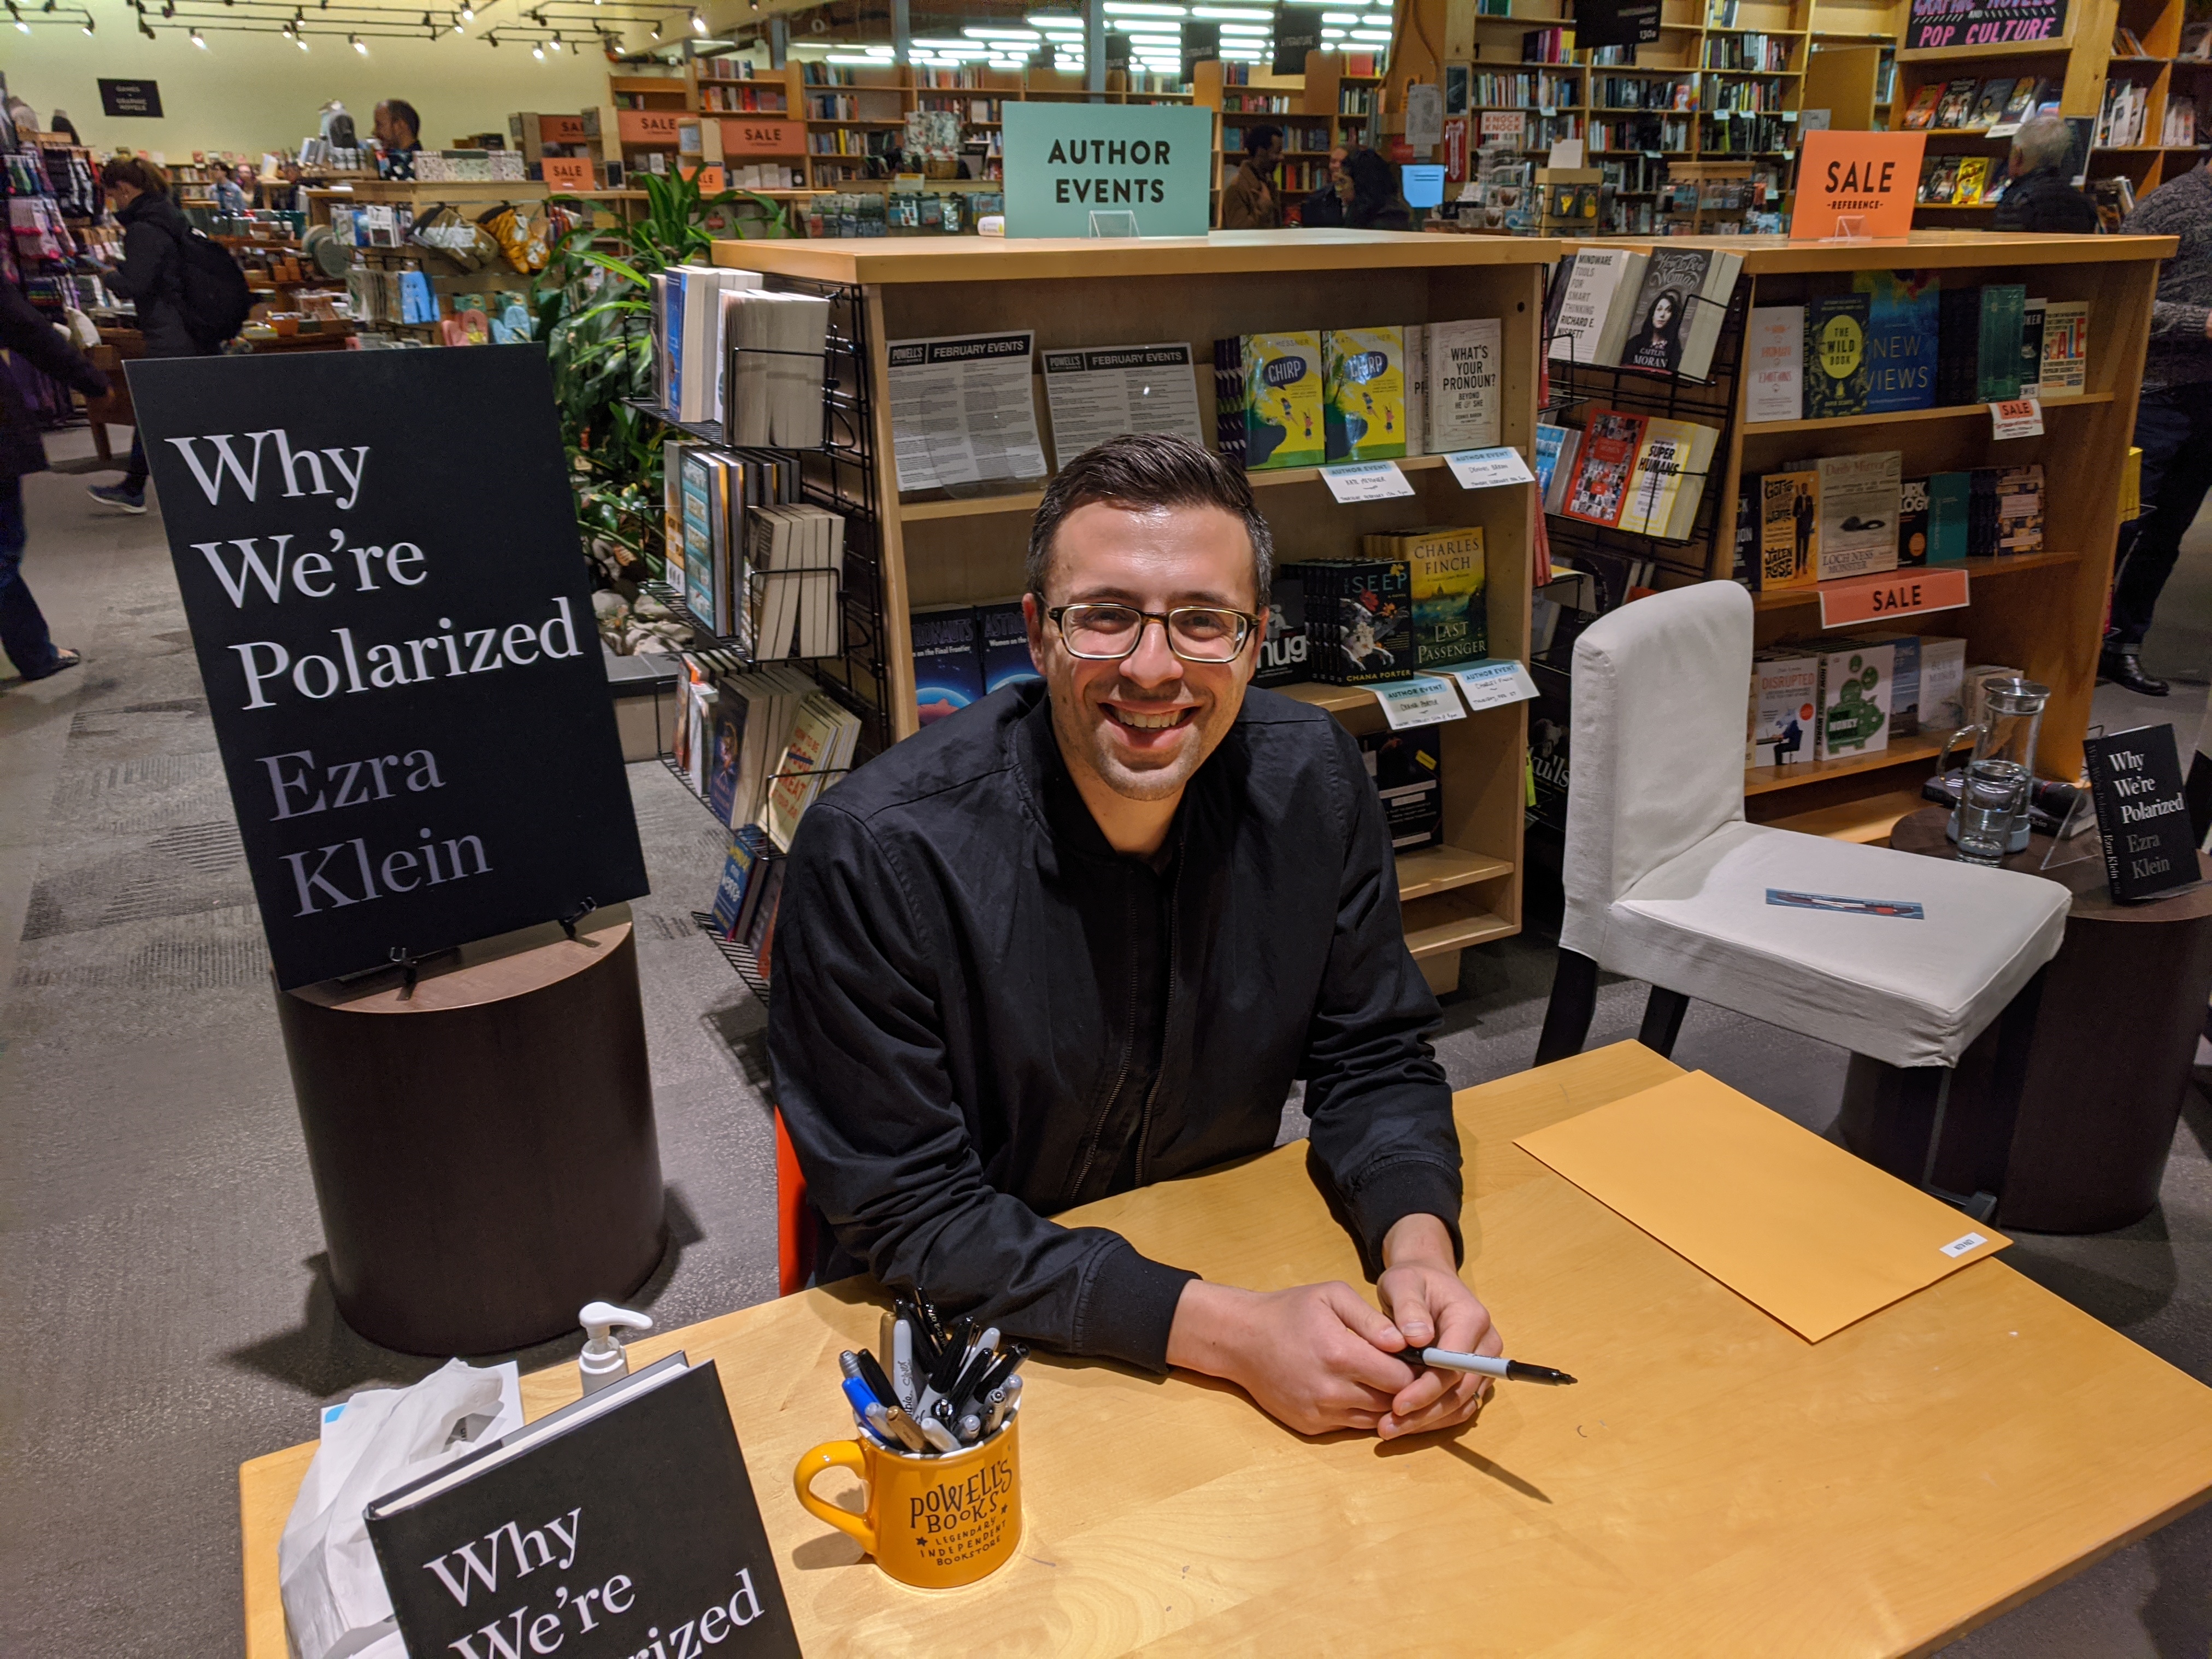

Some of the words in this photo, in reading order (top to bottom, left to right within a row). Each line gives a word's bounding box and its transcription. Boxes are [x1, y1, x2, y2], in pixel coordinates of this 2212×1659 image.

[1919, 25, 1956, 47] POP
[1966, 17, 2057, 45] CULTURE
[642, 117, 676, 130] SALE
[744, 128, 782, 140] SALE
[1048, 139, 1170, 166] AUTHOR
[553, 166, 583, 177] SALE
[1825, 161, 1896, 193] SALE
[1056, 179, 1164, 203] EVENTS
[1578, 254, 1613, 266] MINDWARE
[1575, 266, 1595, 277] TOOLS
[1570, 278, 1584, 289] FOR
[1567, 291, 1591, 302] SMART
[1564, 303, 1595, 315] THINKING
[1560, 315, 1588, 327] RICHARD
[1834, 327, 1849, 337] THE
[2044, 317, 2086, 360] SCALE
[892, 347, 924, 360] POWELL'S
[933, 344, 987, 358] FEBRUARY
[987, 340, 1025, 354] EVENTS
[1451, 344, 1489, 361] WHAT'S
[1640, 348, 1666, 357] CAITLIN
[1827, 339, 1855, 353] WILD
[1873, 334, 1922, 360] NEW
[1049, 356, 1081, 367] POWELL'S
[1092, 354, 1146, 365] FEBRUARY
[1146, 351, 1182, 362] EVENTS
[1633, 354, 1668, 368] MORAN
[1829, 355, 1850, 366] BOOK
[1268, 360, 1302, 383] CHIRP
[1456, 361, 1483, 375] YOUR
[1443, 374, 1496, 391] PRONOUN?
[1458, 392, 1480, 401] BEYOND
[2002, 402, 2030, 416] SALE
[1648, 445, 1676, 461] SUPER
[163, 429, 370, 510] Why
[1331, 466, 1363, 475] AUTHOR
[1364, 464, 1388, 472] EVENT
[1638, 457, 1680, 476] HUMANS
[1414, 537, 1480, 560] CHARLES
[1822, 553, 1850, 566] LOCH
[1851, 549, 1874, 562] NESS
[1425, 556, 1471, 575] FINCH
[1351, 572, 1408, 593] SEEP
[1872, 585, 1922, 612] SALE
[1434, 621, 1469, 643] LAST
[227, 596, 584, 710] Polarized
[1417, 640, 1487, 664] PASSENGER
[1346, 672, 1378, 683] CHANA
[1379, 669, 1411, 679] PORTER
[1466, 669, 1493, 680] AUTHOR
[1495, 664, 1515, 674] EVENT
[1762, 673, 1816, 690] DISRUPTED
[1388, 689, 1417, 698] AUTHOR
[1419, 684, 1443, 693] EVENT
[2107, 750, 2145, 772] Why
[255, 747, 446, 822] Ezra
[2120, 792, 2185, 824] Polarized
[2104, 834, 2114, 855] Ezra
[2126, 834, 2161, 854] Ezra
[279, 827, 493, 918] Klein
[2107, 856, 2119, 879] Klein
[2132, 857, 2171, 879] Klein
[910, 1458, 1013, 1529] POWELL'S
[925, 1491, 999, 1534] BOOKS
[920, 1520, 1006, 1558] INDEPENDENT
[936, 1516, 997, 1545] LEGENDARY
[422, 1507, 582, 1608] Why
[937, 1534, 1001, 1566] BOOKSTORE
